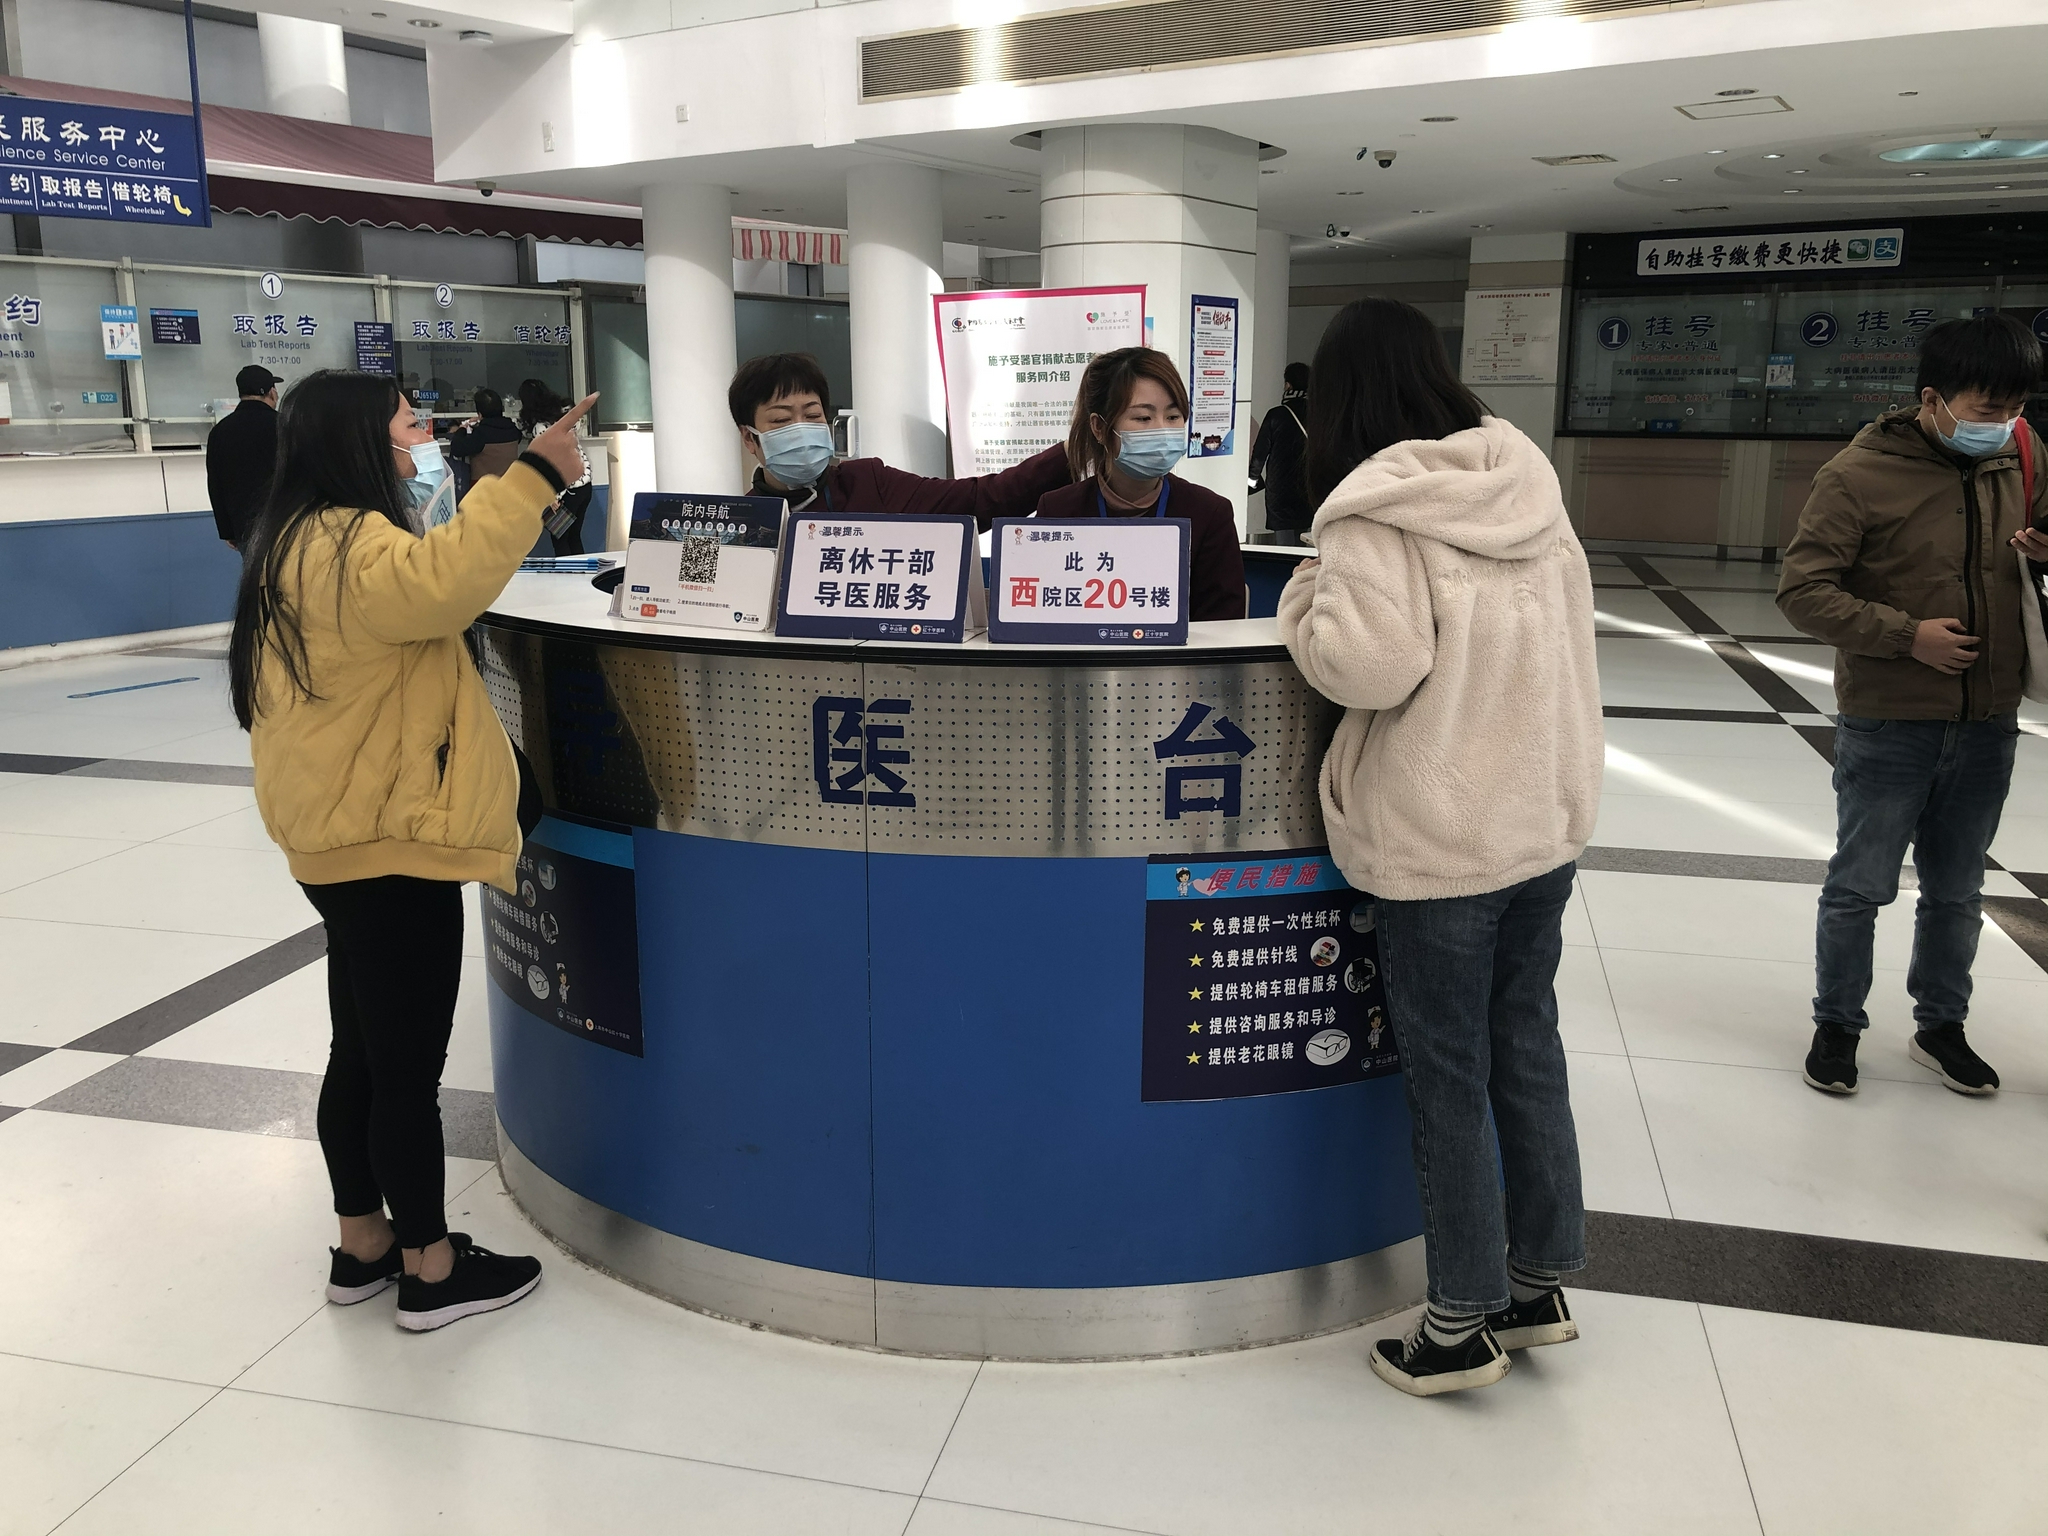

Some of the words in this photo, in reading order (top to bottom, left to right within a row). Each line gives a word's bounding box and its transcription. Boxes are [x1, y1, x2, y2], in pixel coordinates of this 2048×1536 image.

[0, 144, 46, 161] ience
[54, 148, 109, 166] Service
[116, 154, 166, 171] Center
[10, 173, 30, 194] 约
[40, 176, 104, 200] 取报告
[111, 181, 172, 205] 借轮椅
[0, 196, 33, 207] intment
[42, 199, 57, 208] Lab
[57, 200, 75, 210] Test
[78, 202, 108, 212] Reports
[124, 205, 166, 216] Wheelchair
[1644, 238, 1843, 270] 自助挂号缴费更快捷
[3, 293, 42, 327] 约
[1856, 307, 1938, 333] 挂号
[232, 313, 319, 337] 取报告
[411, 319, 481, 341] 取报告
[513, 323, 572, 345] 借轮椅
[1644, 314, 1716, 338] 挂号
[240, 339, 257, 348] Lab
[259, 339, 277, 349] Test
[278, 340, 311, 351] Reports
[259, 356, 301, 365] 7:30-17:00
[1016, 370, 1071, 384] 服务网介绍
[681, 502, 730, 520] 院内导航
[818, 525, 864, 538] 温馨提示
[1028, 530, 1075, 543] 温馨提示
[819, 546, 936, 576] 离休干部
[1064, 551, 1115, 572] 此为
[814, 581, 932, 611] 导医服务
[1009, 576, 1171, 609] 西院区20号楼
[811, 695, 917, 808] 医
[1153, 700, 1258, 821] 台
[1206, 861, 1323, 892] 便民措施
[1212, 908, 1341, 936] 免费提供一次性纸杯
[1211, 944, 1299, 969] 免费提供针线
[1210, 973, 1339, 1002] 提供轮椅车租借服务
[1209, 1005, 1337, 1035] 提供咨询服务和导诊
[1208, 1041, 1295, 1067] 提供老花眼镜
